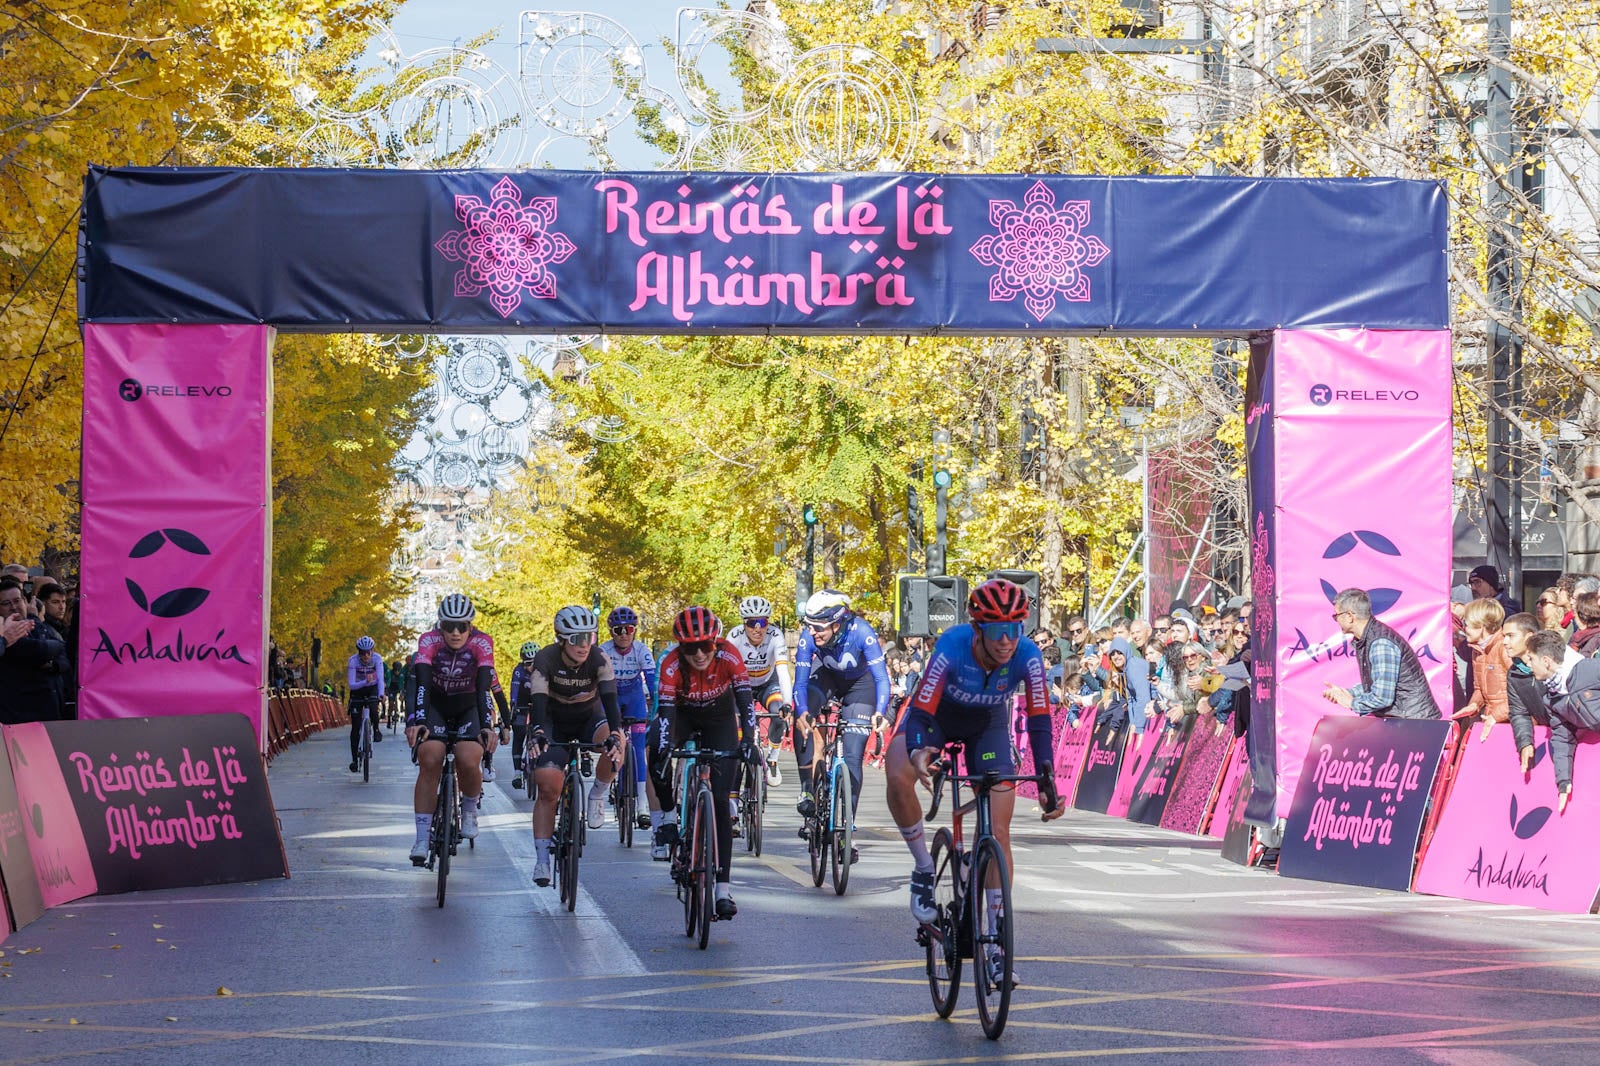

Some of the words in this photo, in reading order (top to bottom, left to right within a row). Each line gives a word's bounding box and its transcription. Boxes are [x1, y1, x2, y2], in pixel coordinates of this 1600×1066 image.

[812, 183, 886, 235] de
[145, 385, 232, 398] RELEVO
[1336, 390, 1419, 401] RELEVO
[89, 627, 250, 665] Andalucía
[918, 652, 950, 703] CERATIZIT
[1026, 657, 1047, 709] CERATIZIT
[178, 747, 217, 787] de
[1375, 749, 1401, 791] de
[1463, 846, 1549, 896] Andalucía
